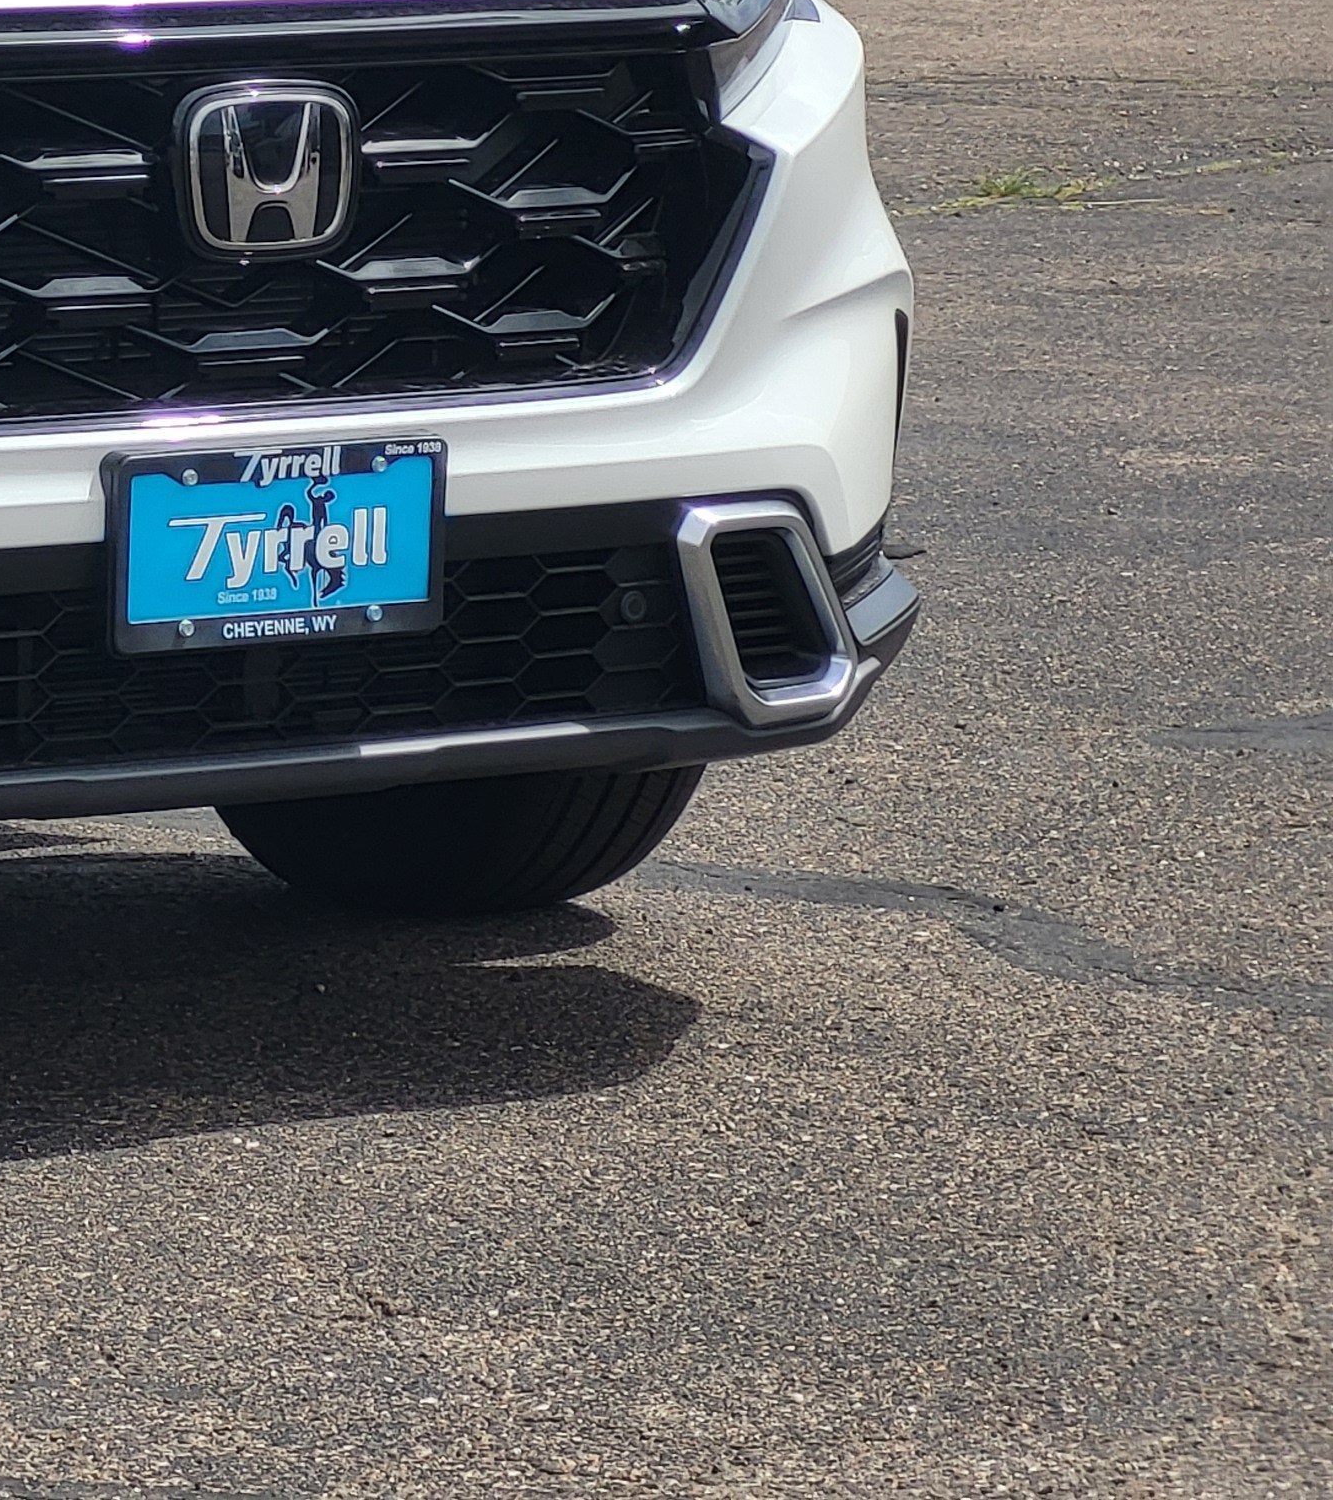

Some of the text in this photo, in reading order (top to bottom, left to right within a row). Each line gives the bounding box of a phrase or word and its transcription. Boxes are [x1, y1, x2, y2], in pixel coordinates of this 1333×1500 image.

[384, 443, 416, 456] Since
[234, 445, 341, 487] Tyrrell
[168, 506, 387, 589] Tyrrell
[217, 591, 250, 605] Since
[222, 614, 338, 640] CHEYENNE, WY
